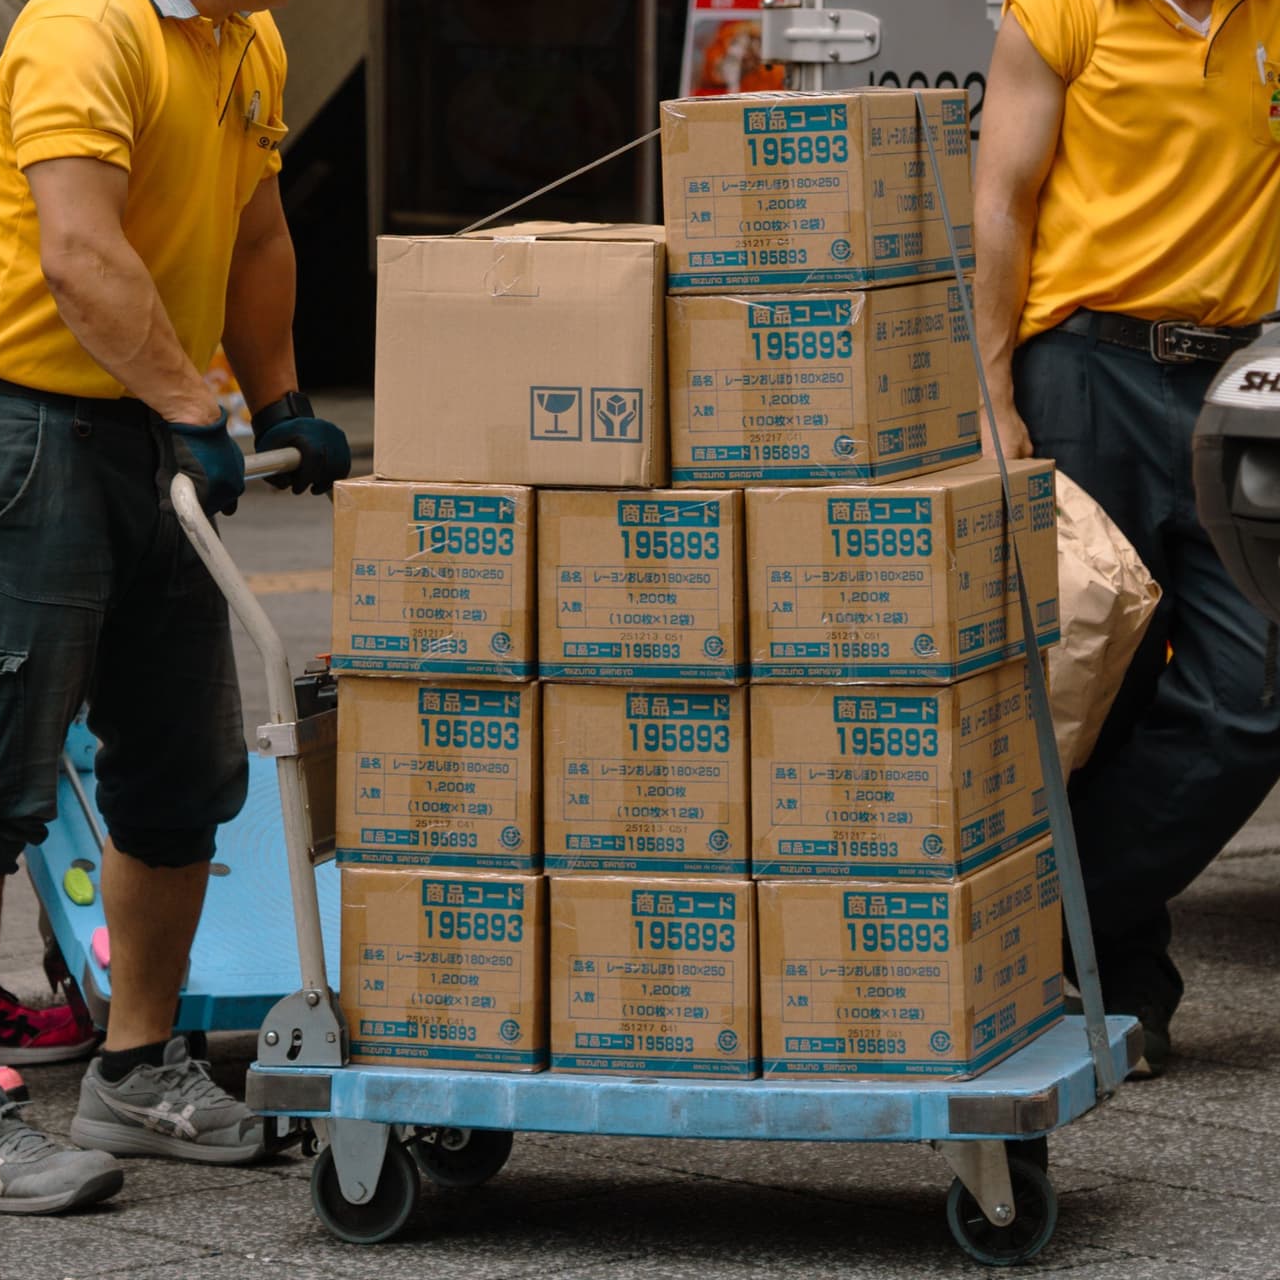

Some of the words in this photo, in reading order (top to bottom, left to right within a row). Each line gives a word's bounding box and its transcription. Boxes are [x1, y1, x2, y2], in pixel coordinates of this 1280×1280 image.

[748, 109, 846, 132] 商品コード
[748, 136, 848, 167] 195893
[688, 182, 709, 193] 品名
[757, 198, 806, 211] 1,200枚
[689, 212, 710, 223] 入数
[691, 252, 747, 266] 商品コード
[751, 249, 807, 266] 195893
[753, 304, 850, 326] 商品コード
[753, 331, 852, 361] 195893
[692, 376, 713, 387] 品名
[761, 393, 810, 406] 1,200枚
[693, 405, 713, 417] 入数
[693, 447, 749, 460] 商品コード
[754, 444, 810, 461] 195893
[417, 498, 514, 521] 商品コード
[621, 503, 718, 526] 商品コード
[832, 502, 930, 522] 商品コード
[416, 525, 514, 556] 195893
[622, 531, 720, 561] 195893
[832, 529, 932, 557] 195893
[771, 571, 792, 582] 品名
[840, 591, 889, 603] 1,200枚
[772, 602, 792, 613] 入数
[625, 643, 679, 658] 195893
[772, 644, 829, 656] 商品コード
[833, 643, 889, 658] 195893
[422, 691, 519, 716] 商品コード
[630, 696, 728, 719] 商品コード
[837, 699, 937, 723] 商品コード
[422, 719, 520, 751] 195893
[629, 724, 730, 754] 195893
[838, 727, 939, 758] 195893
[776, 768, 798, 780] 品名
[844, 790, 897, 802] 1,200枚
[776, 799, 799, 811] 入数
[422, 831, 476, 847] 195893
[629, 836, 685, 853] 195893
[779, 842, 837, 854] 商品コード
[841, 841, 897, 856] 195893
[425, 883, 522, 908] 商品コード
[635, 892, 734, 918] 商品コード
[848, 896, 947, 917] 商品コード
[424, 911, 523, 943] 195893
[636, 921, 735, 954] 195893
[848, 924, 949, 953] 195893
[786, 965, 807, 976] 品名
[856, 986, 906, 999] 1,200枚
[787, 996, 808, 1007] 入数
[421, 1023, 477, 1041] 195893
[637, 1035, 692, 1052] 195893
[787, 1039, 844, 1051] 商品コード
[849, 1038, 906, 1054] 195893
